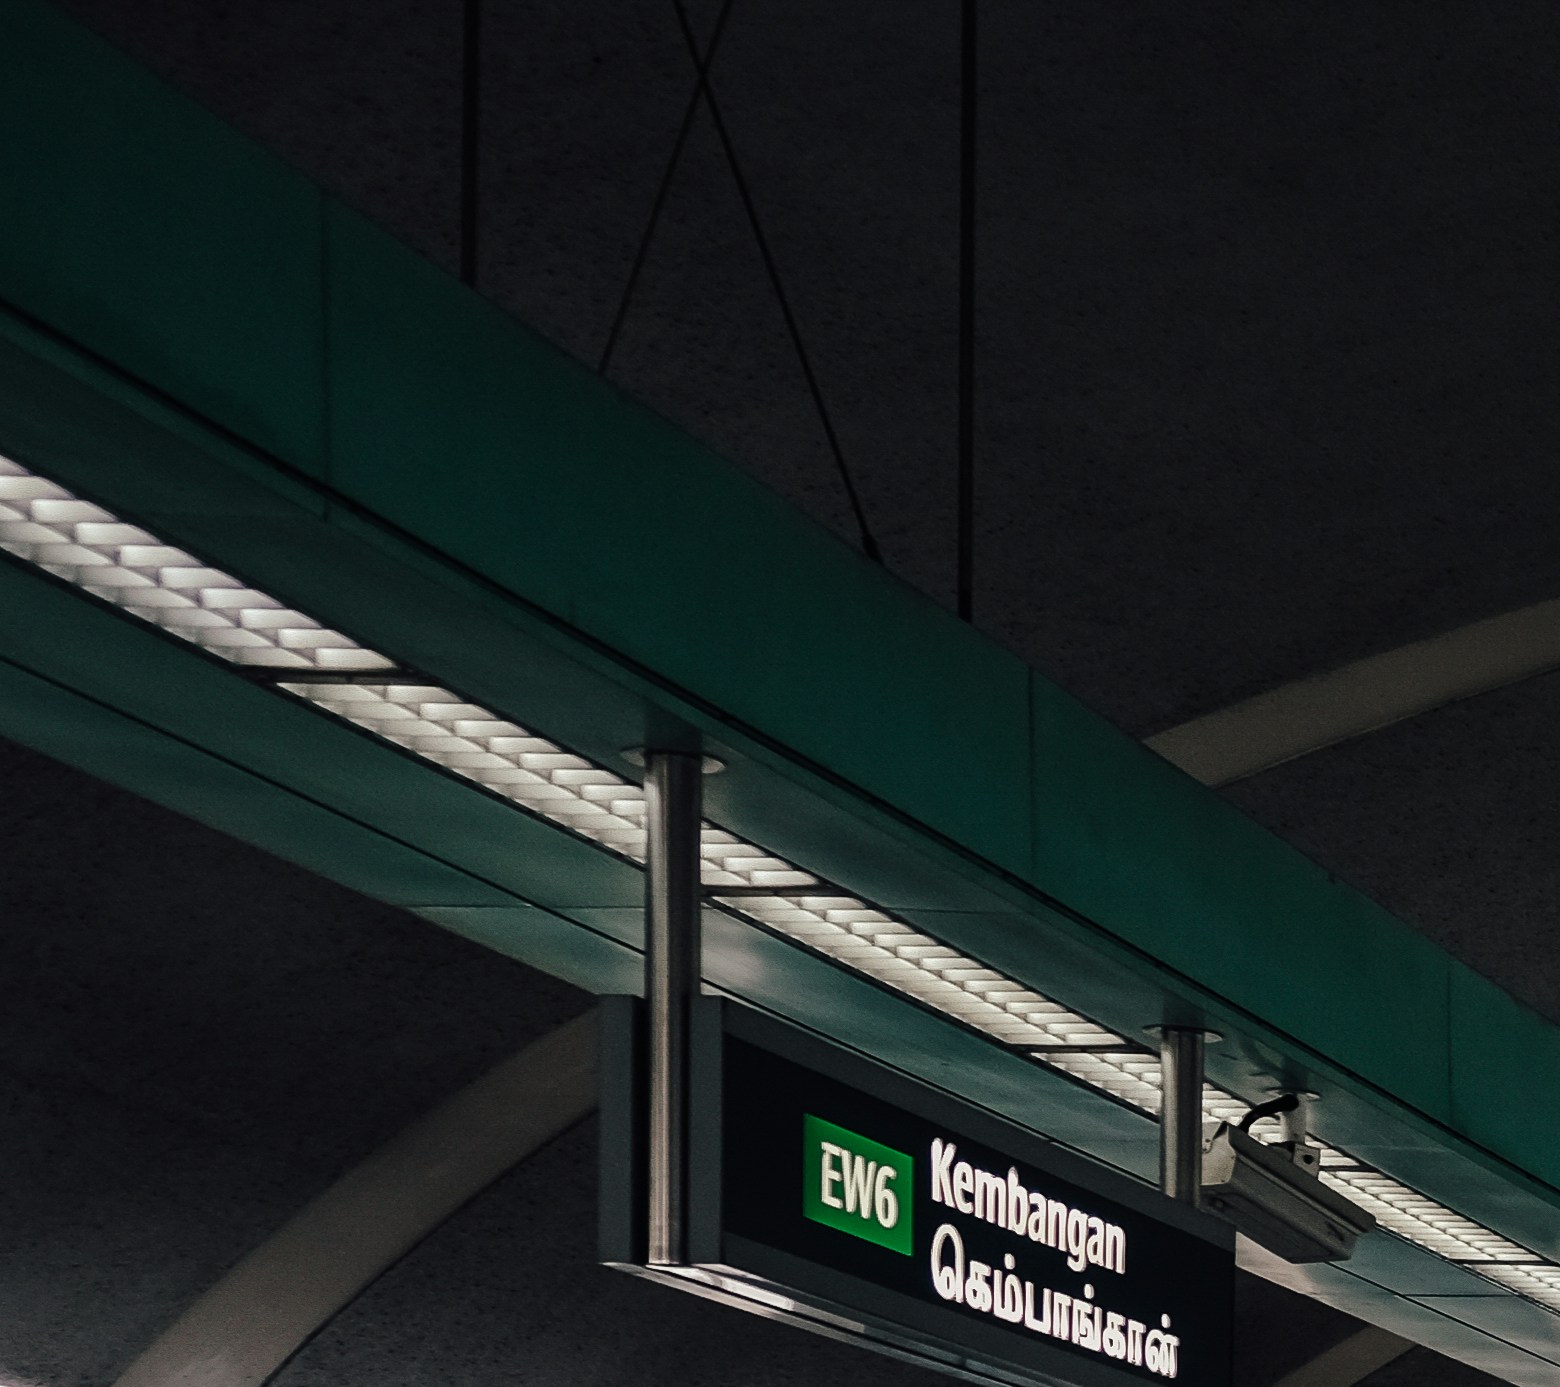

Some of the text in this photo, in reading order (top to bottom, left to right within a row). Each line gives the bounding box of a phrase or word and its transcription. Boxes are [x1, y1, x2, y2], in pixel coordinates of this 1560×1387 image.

[820, 1141, 899, 1230] EW6
[929, 1137, 1127, 1275] Kembangan
[929, 1223, 1180, 1379] கெம்பாங்கான்
